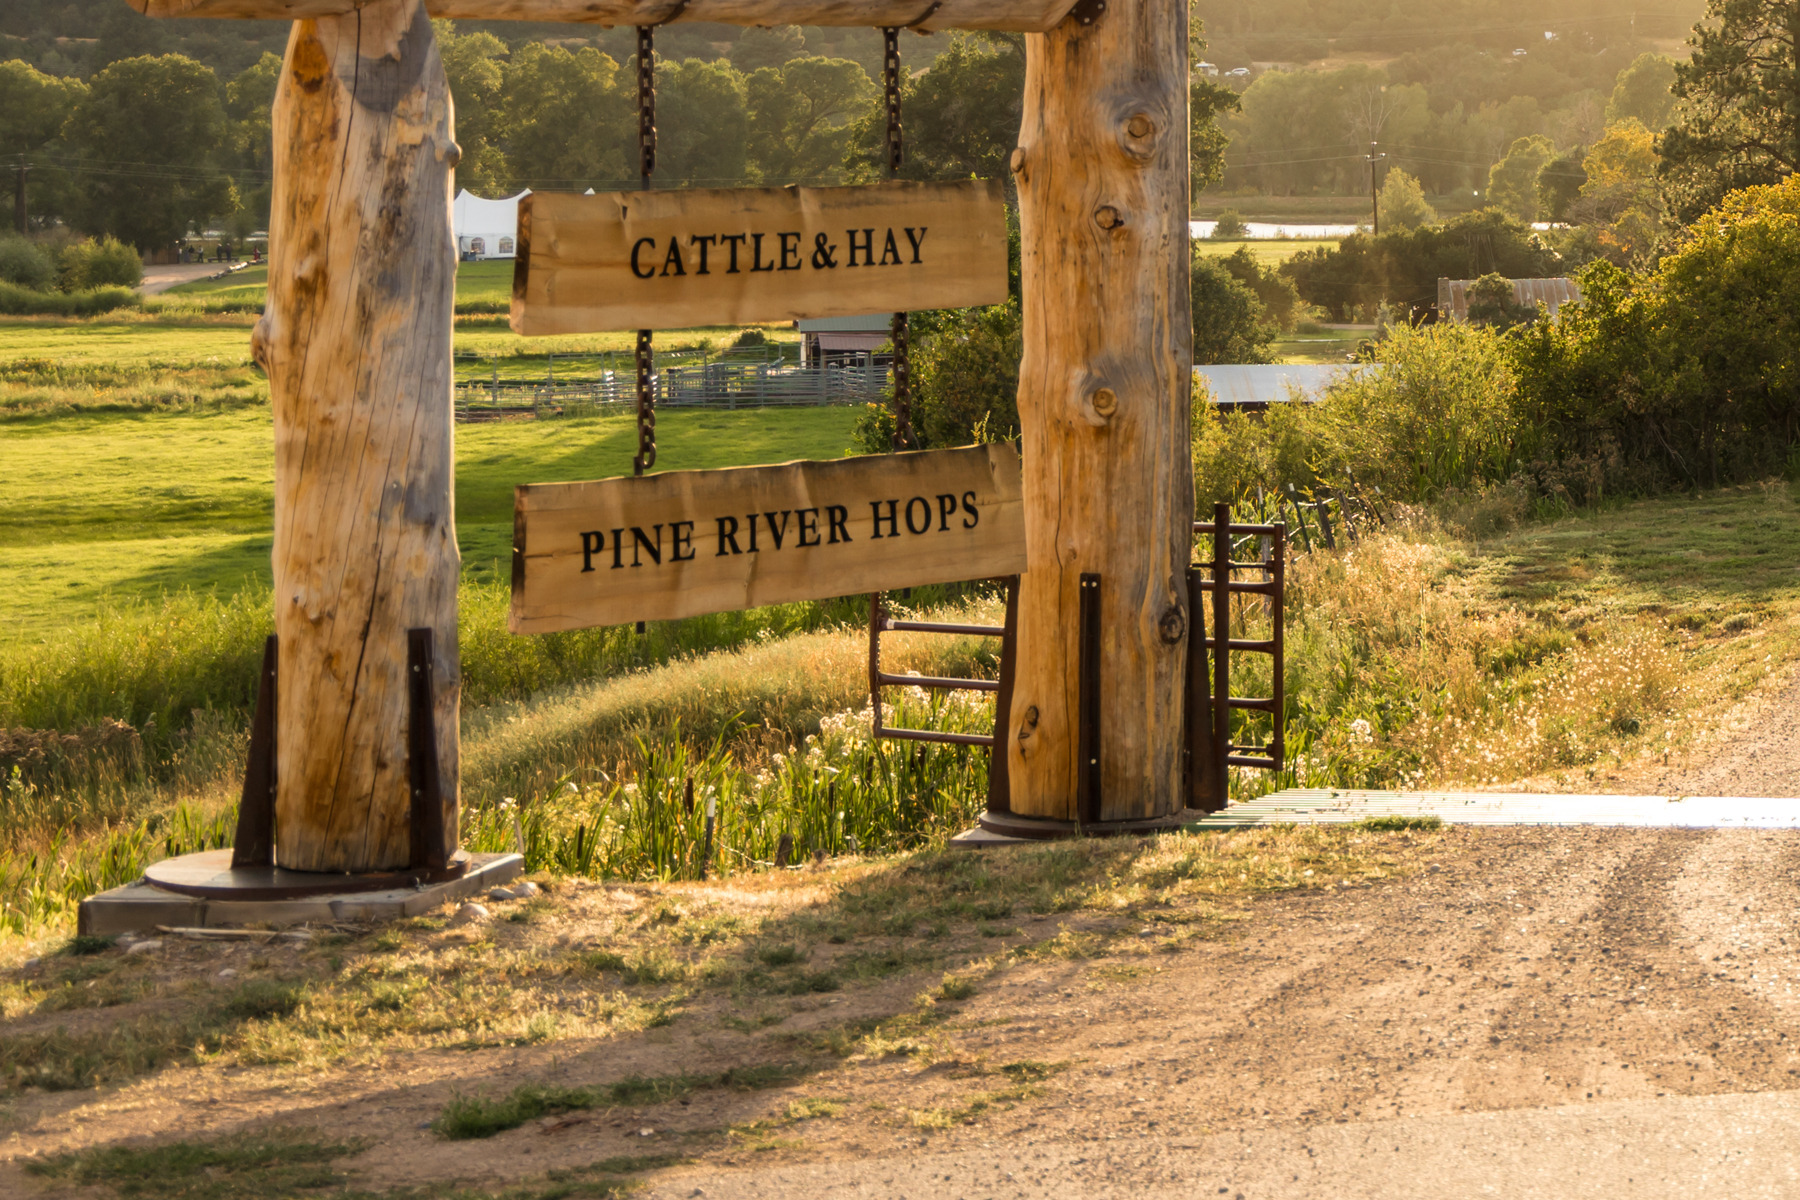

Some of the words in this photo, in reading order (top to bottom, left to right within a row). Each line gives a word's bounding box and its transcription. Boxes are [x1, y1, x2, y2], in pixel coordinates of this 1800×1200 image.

[575, 519, 697, 574] PINE
[714, 503, 854, 558] RIVER
[868, 490, 981, 540] HOPS
